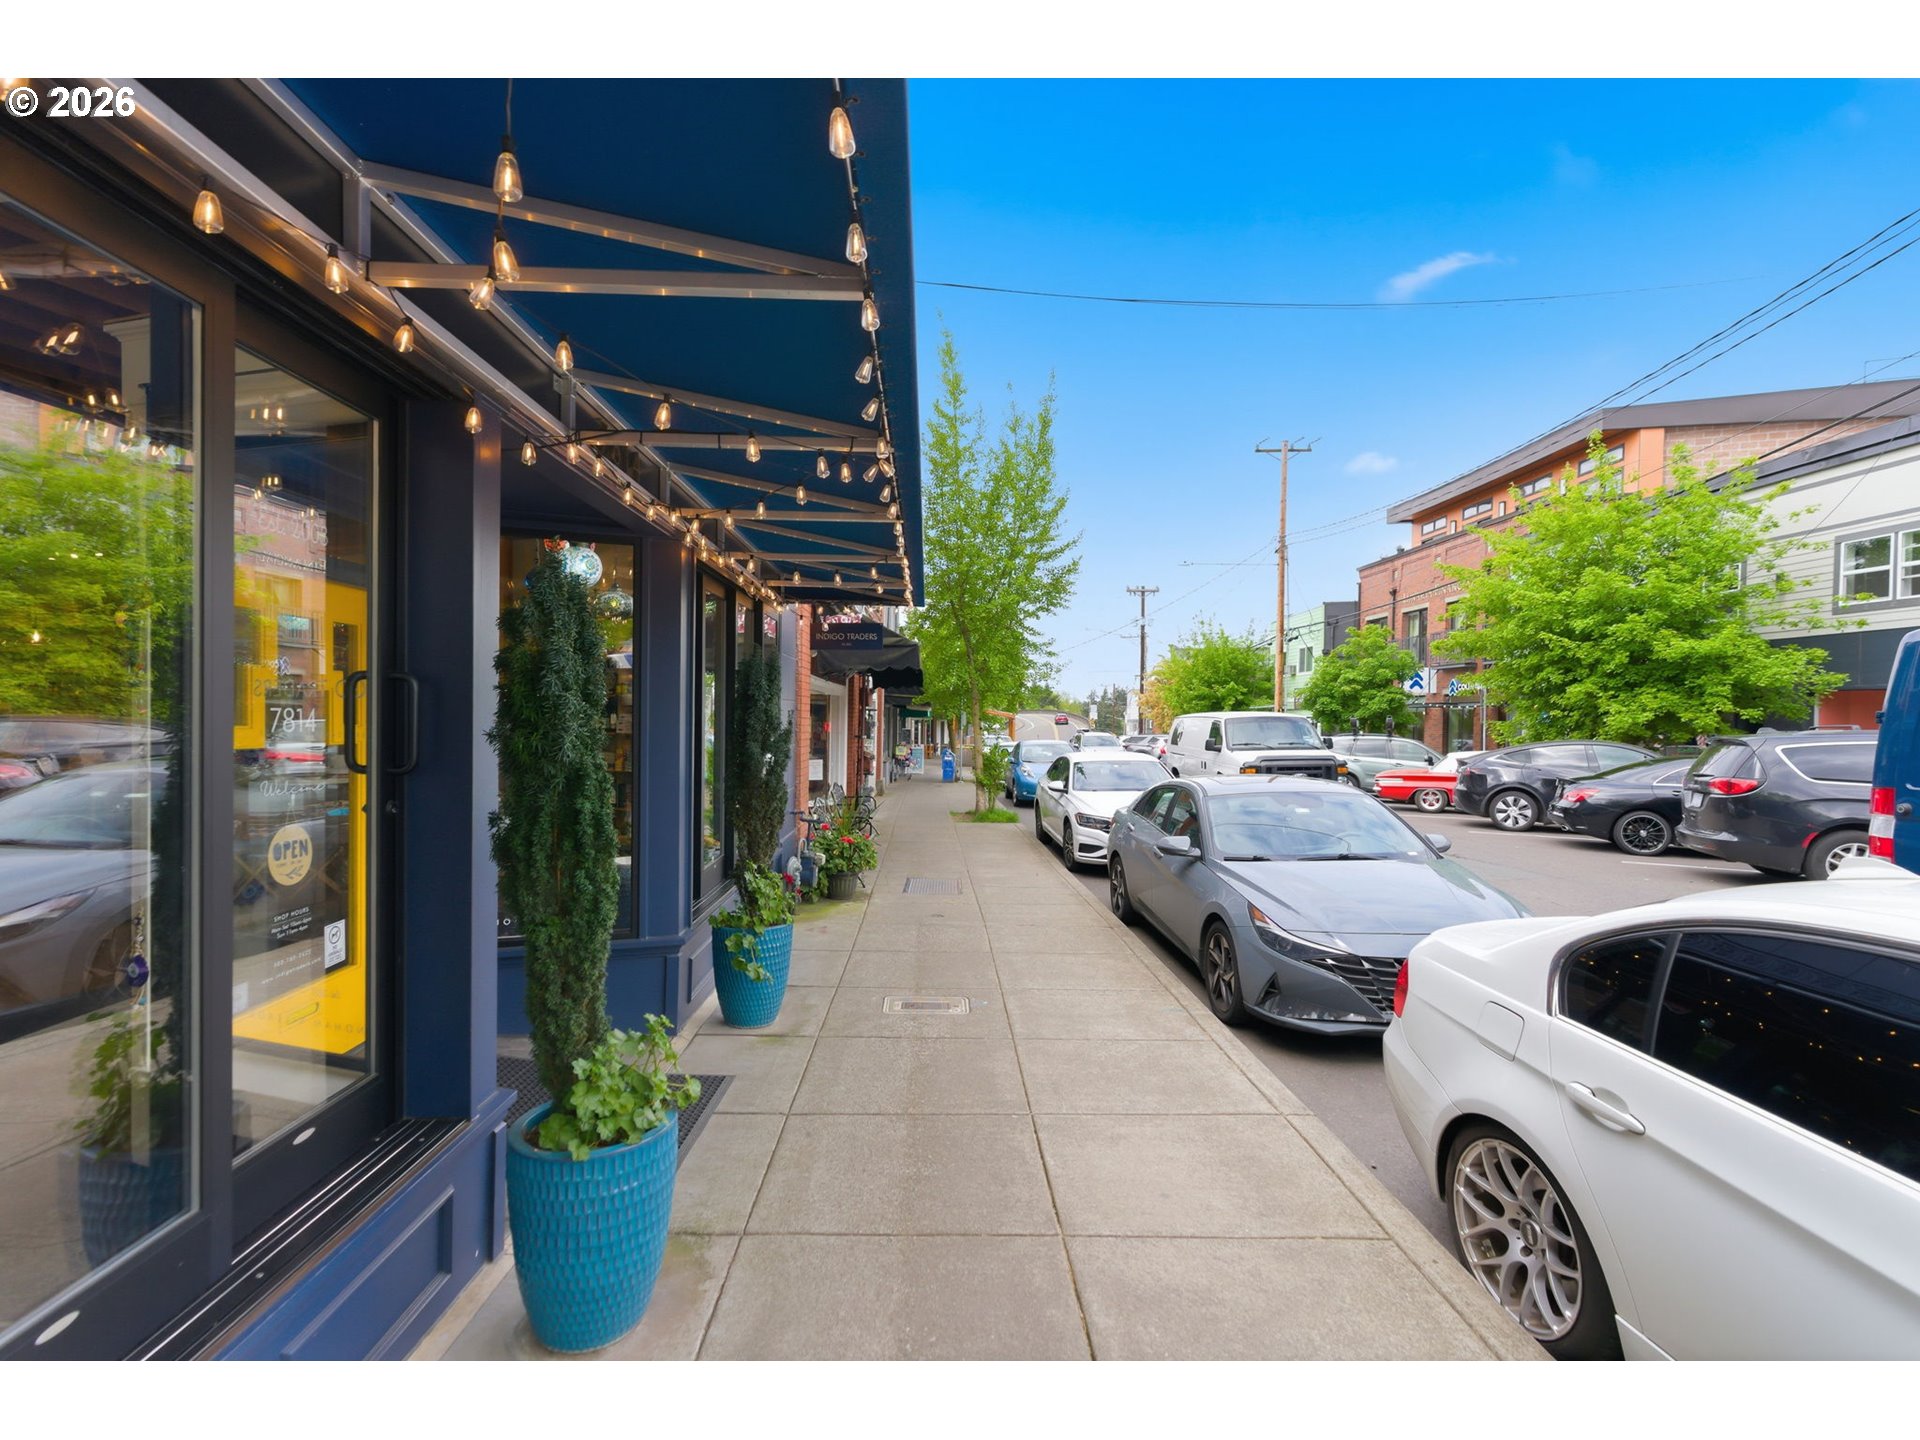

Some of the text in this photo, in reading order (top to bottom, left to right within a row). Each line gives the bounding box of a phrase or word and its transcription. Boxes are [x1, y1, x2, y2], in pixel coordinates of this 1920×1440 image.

[816, 632, 878, 641] INDIGO TRADERS
[270, 707, 317, 733] 7814
[260, 780, 326, 797] Welcome
[272, 839, 309, 862] OPEN
[273, 907, 310, 923] SHOP HOURS
